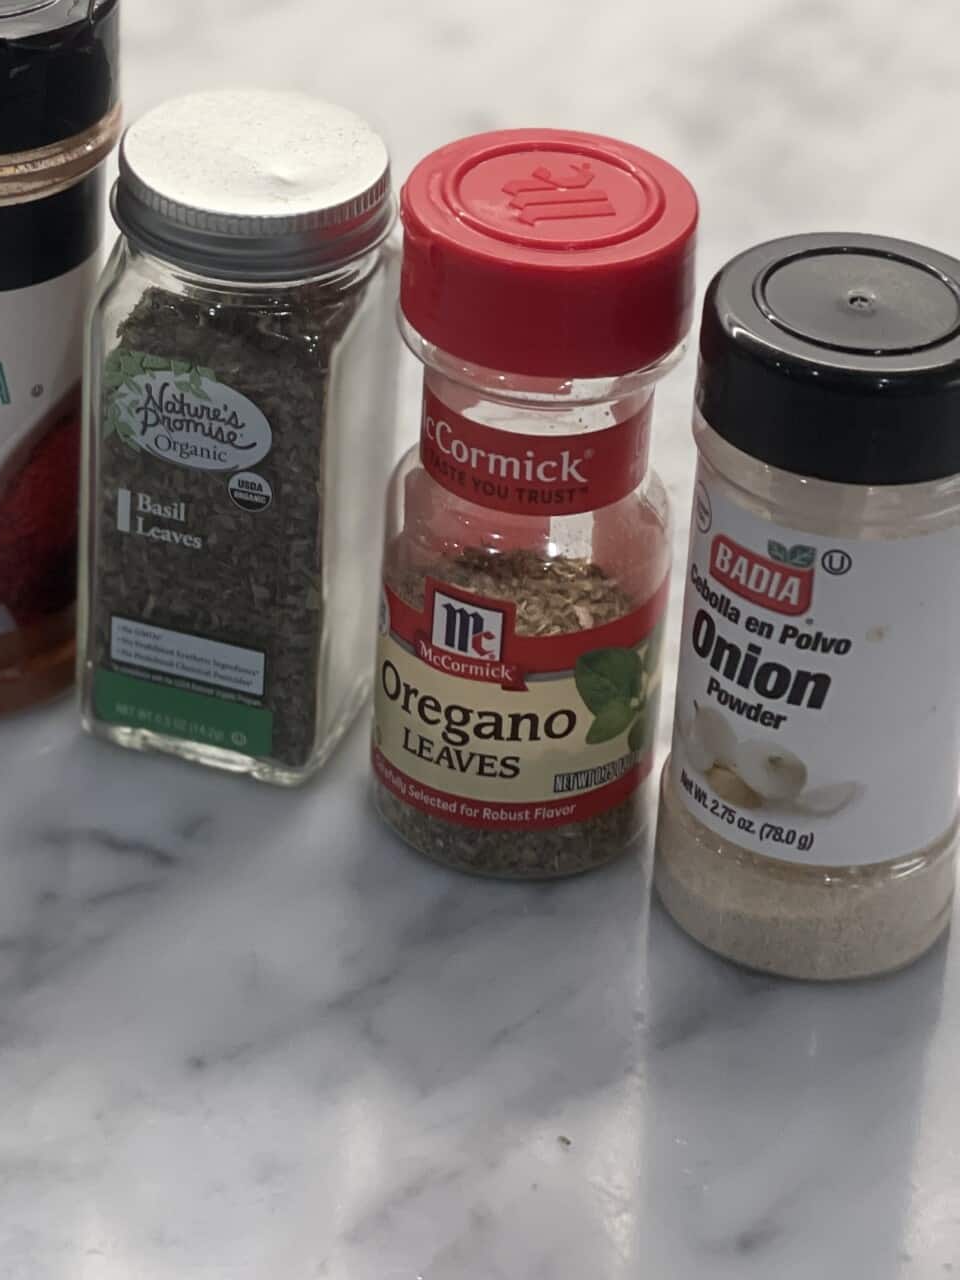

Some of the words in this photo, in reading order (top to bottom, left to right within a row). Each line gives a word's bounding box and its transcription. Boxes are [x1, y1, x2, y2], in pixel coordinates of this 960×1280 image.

[135, 406, 258, 450] Promise
[144, 382, 246, 430] Nature's
[153, 434, 228, 463] Organic
[424, 414, 589, 484] cCormick
[137, 492, 187, 523] Basil
[471, 477, 510, 499] YOU
[135, 515, 204, 551] Leaves
[714, 541, 802, 607] BADIA
[691, 608, 832, 710] Onion
[745, 618, 774, 641] en
[779, 626, 853, 656] Polvo
[419, 639, 514, 682] McCormick
[381, 659, 578, 746] Oregano
[706, 676, 788, 731] Powder
[401, 727, 521, 780] LEAVES
[408, 783, 458, 814] Selected
[459, 802, 481, 819] for
[482, 806, 531, 822] Robust
[533, 803, 577, 820] Flavor
[710, 799, 737, 825] 2.75
[737, 817, 757, 835] oz.
[759, 822, 797, 846] (78.0
[797, 831, 815, 852] g)
